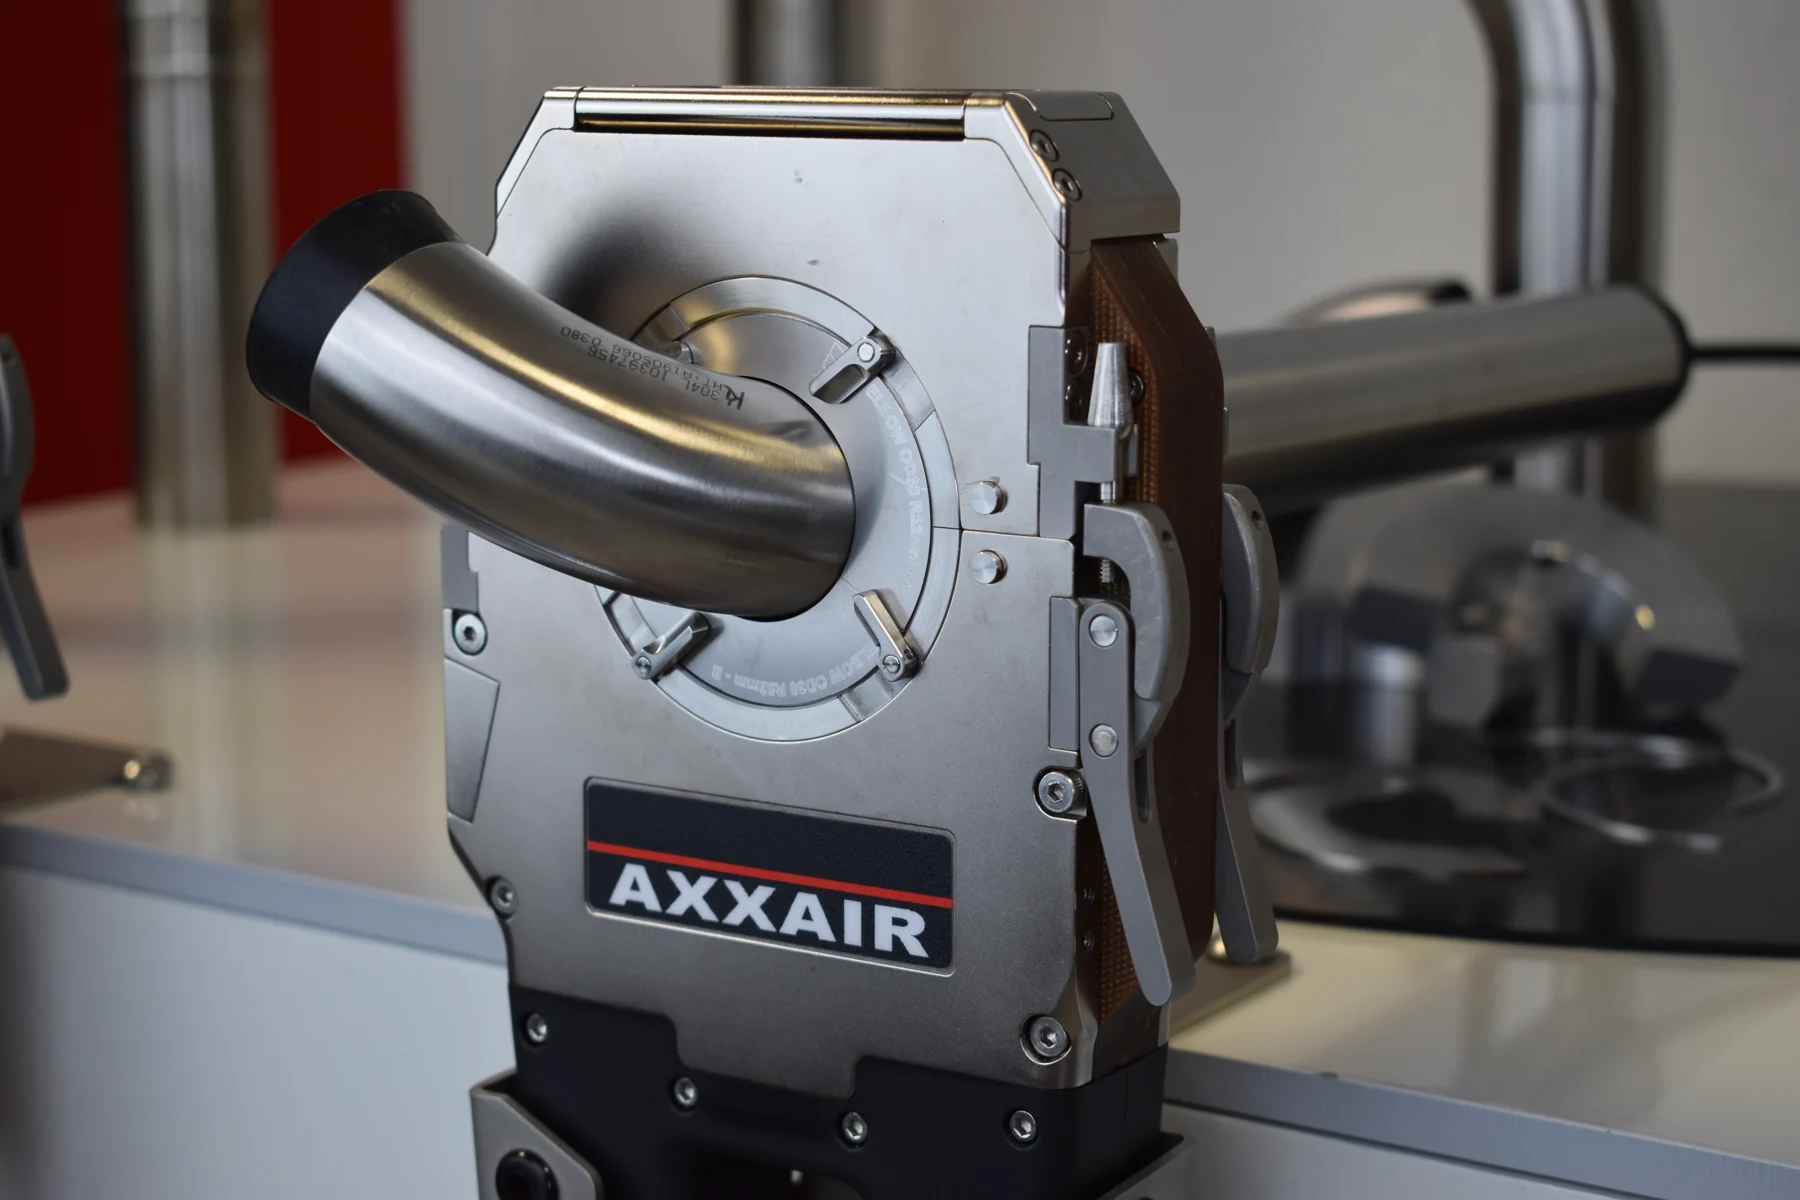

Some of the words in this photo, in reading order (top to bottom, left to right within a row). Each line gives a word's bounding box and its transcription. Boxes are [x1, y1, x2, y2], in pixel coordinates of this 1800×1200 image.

[560, 326, 603, 347] 0380
[588, 344, 669, 382] 10397456
[685, 378, 721, 401] 304L
[608, 862, 930, 958] AXXAIR
